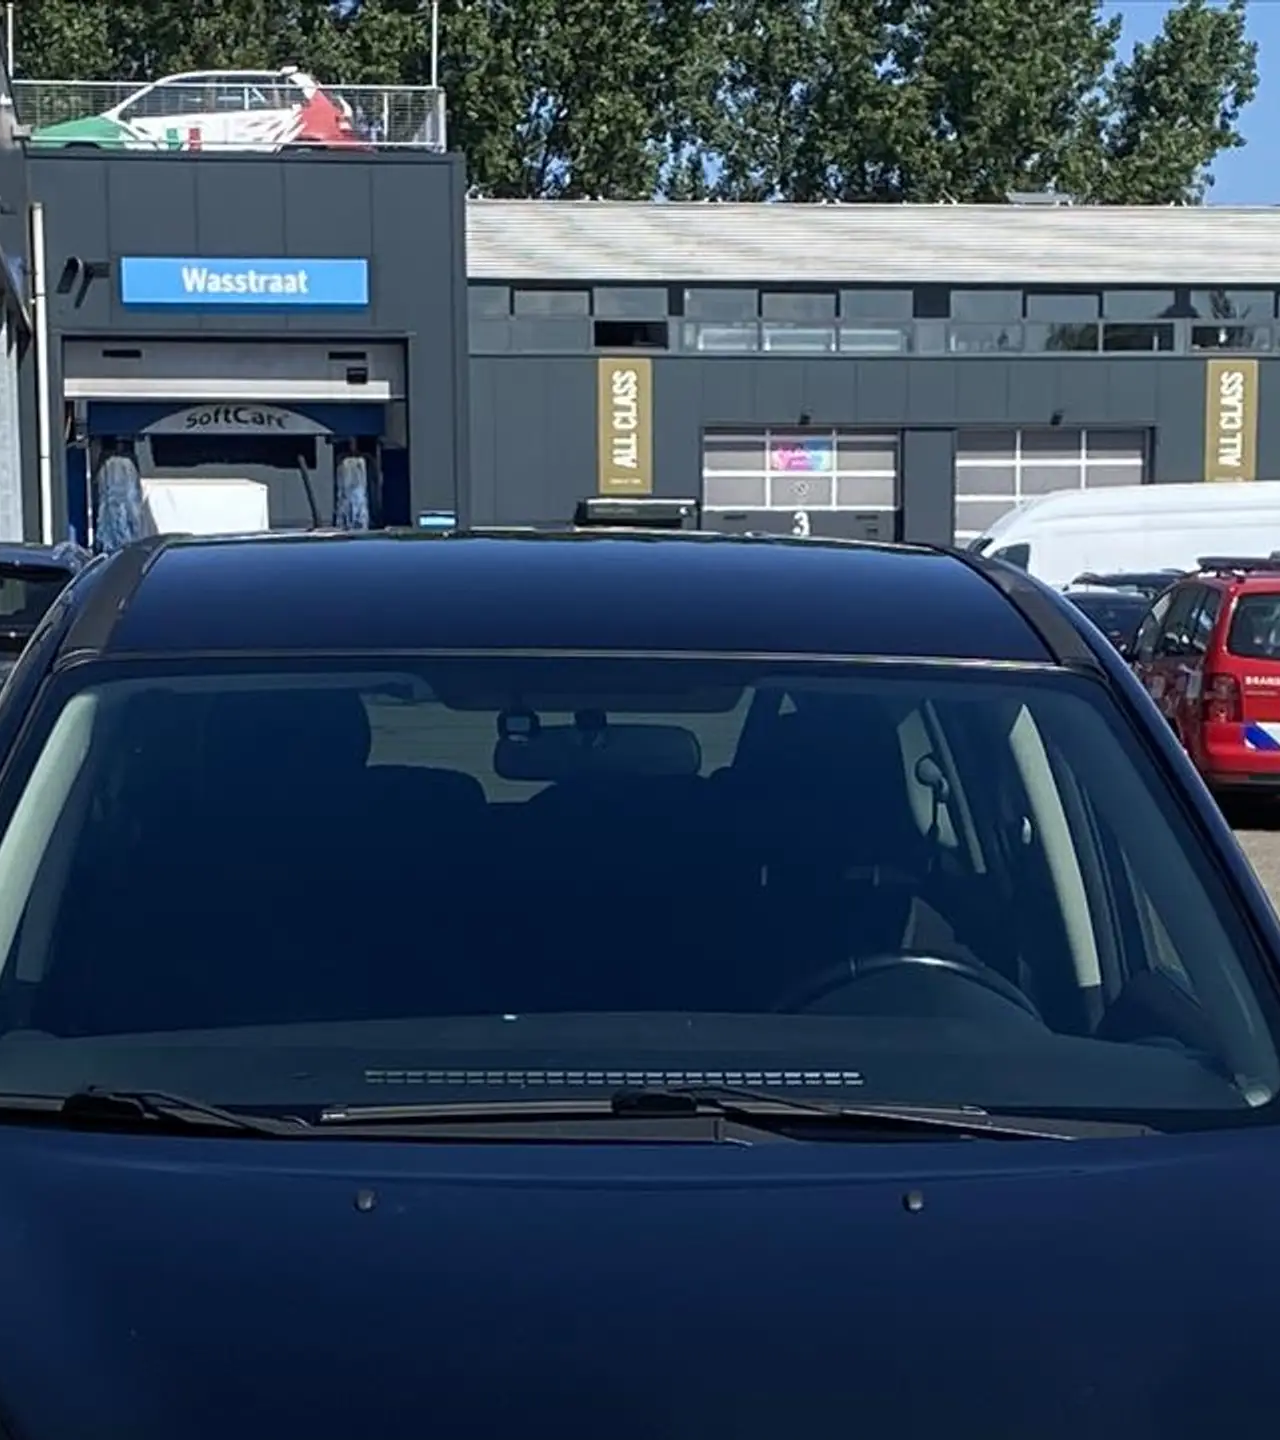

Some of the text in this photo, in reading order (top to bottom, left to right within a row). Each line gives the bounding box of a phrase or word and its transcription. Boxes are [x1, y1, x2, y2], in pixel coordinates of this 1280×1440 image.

[181, 266, 309, 294] Wasstraat
[612, 369, 638, 430] CLASS
[1219, 371, 1244, 429] CLASS
[612, 432, 638, 468] ALL
[1218, 431, 1243, 466] ALL
[792, 511, 810, 536] 3
